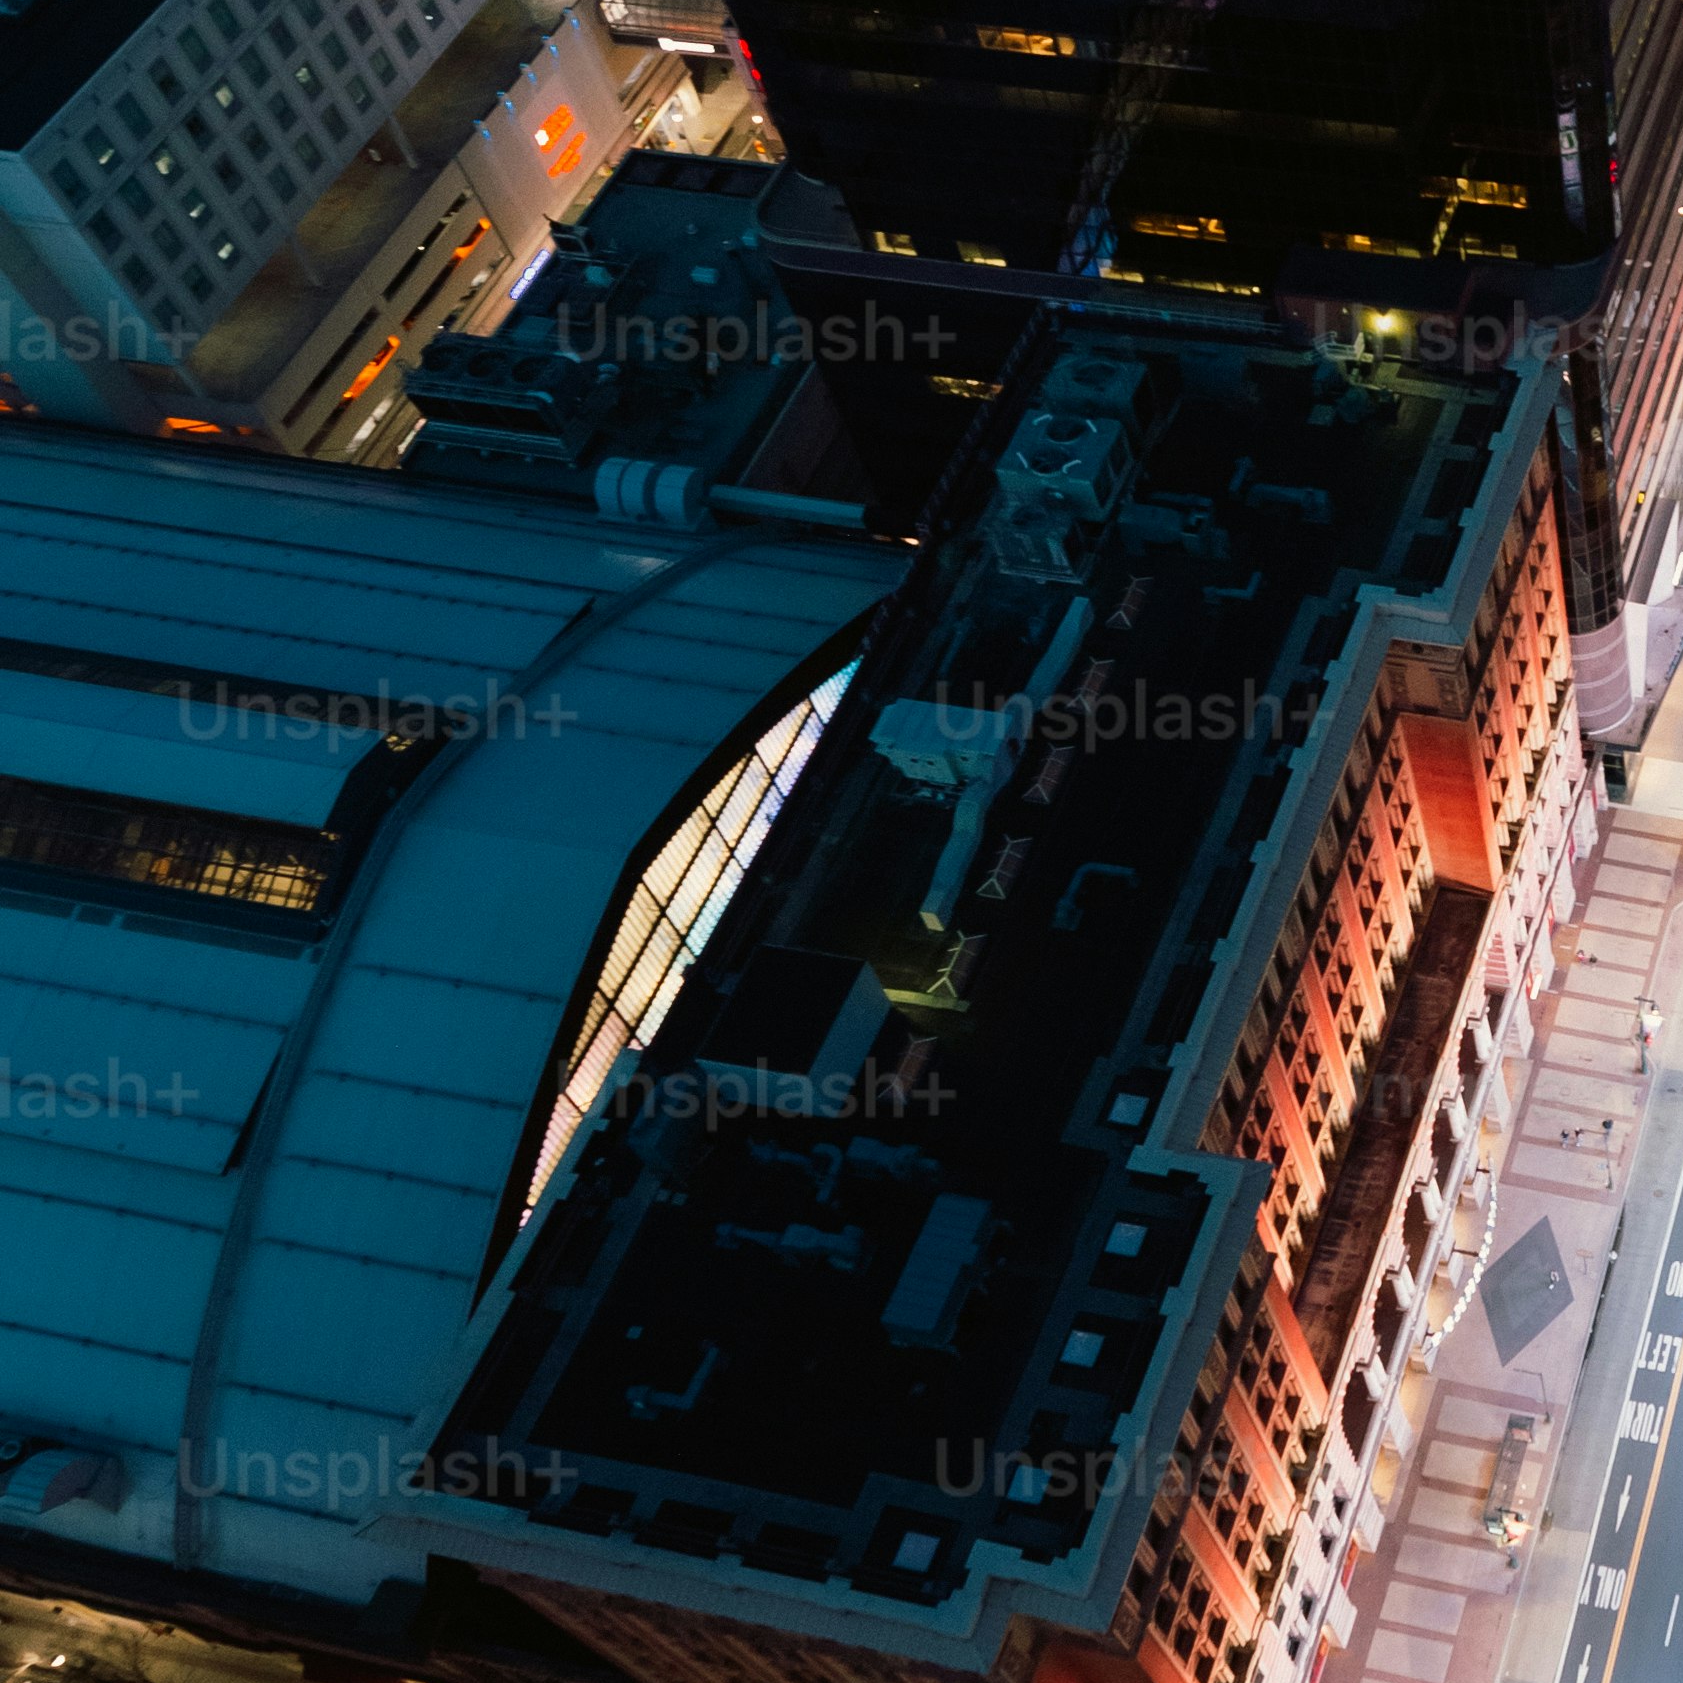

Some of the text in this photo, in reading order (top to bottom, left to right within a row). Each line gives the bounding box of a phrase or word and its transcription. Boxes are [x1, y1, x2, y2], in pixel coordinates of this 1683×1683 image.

[1637, 1331, 1683, 1374] LEFT
[1619, 1400, 1665, 1444] TURN
[1580, 1563, 1627, 1611] ONLY
